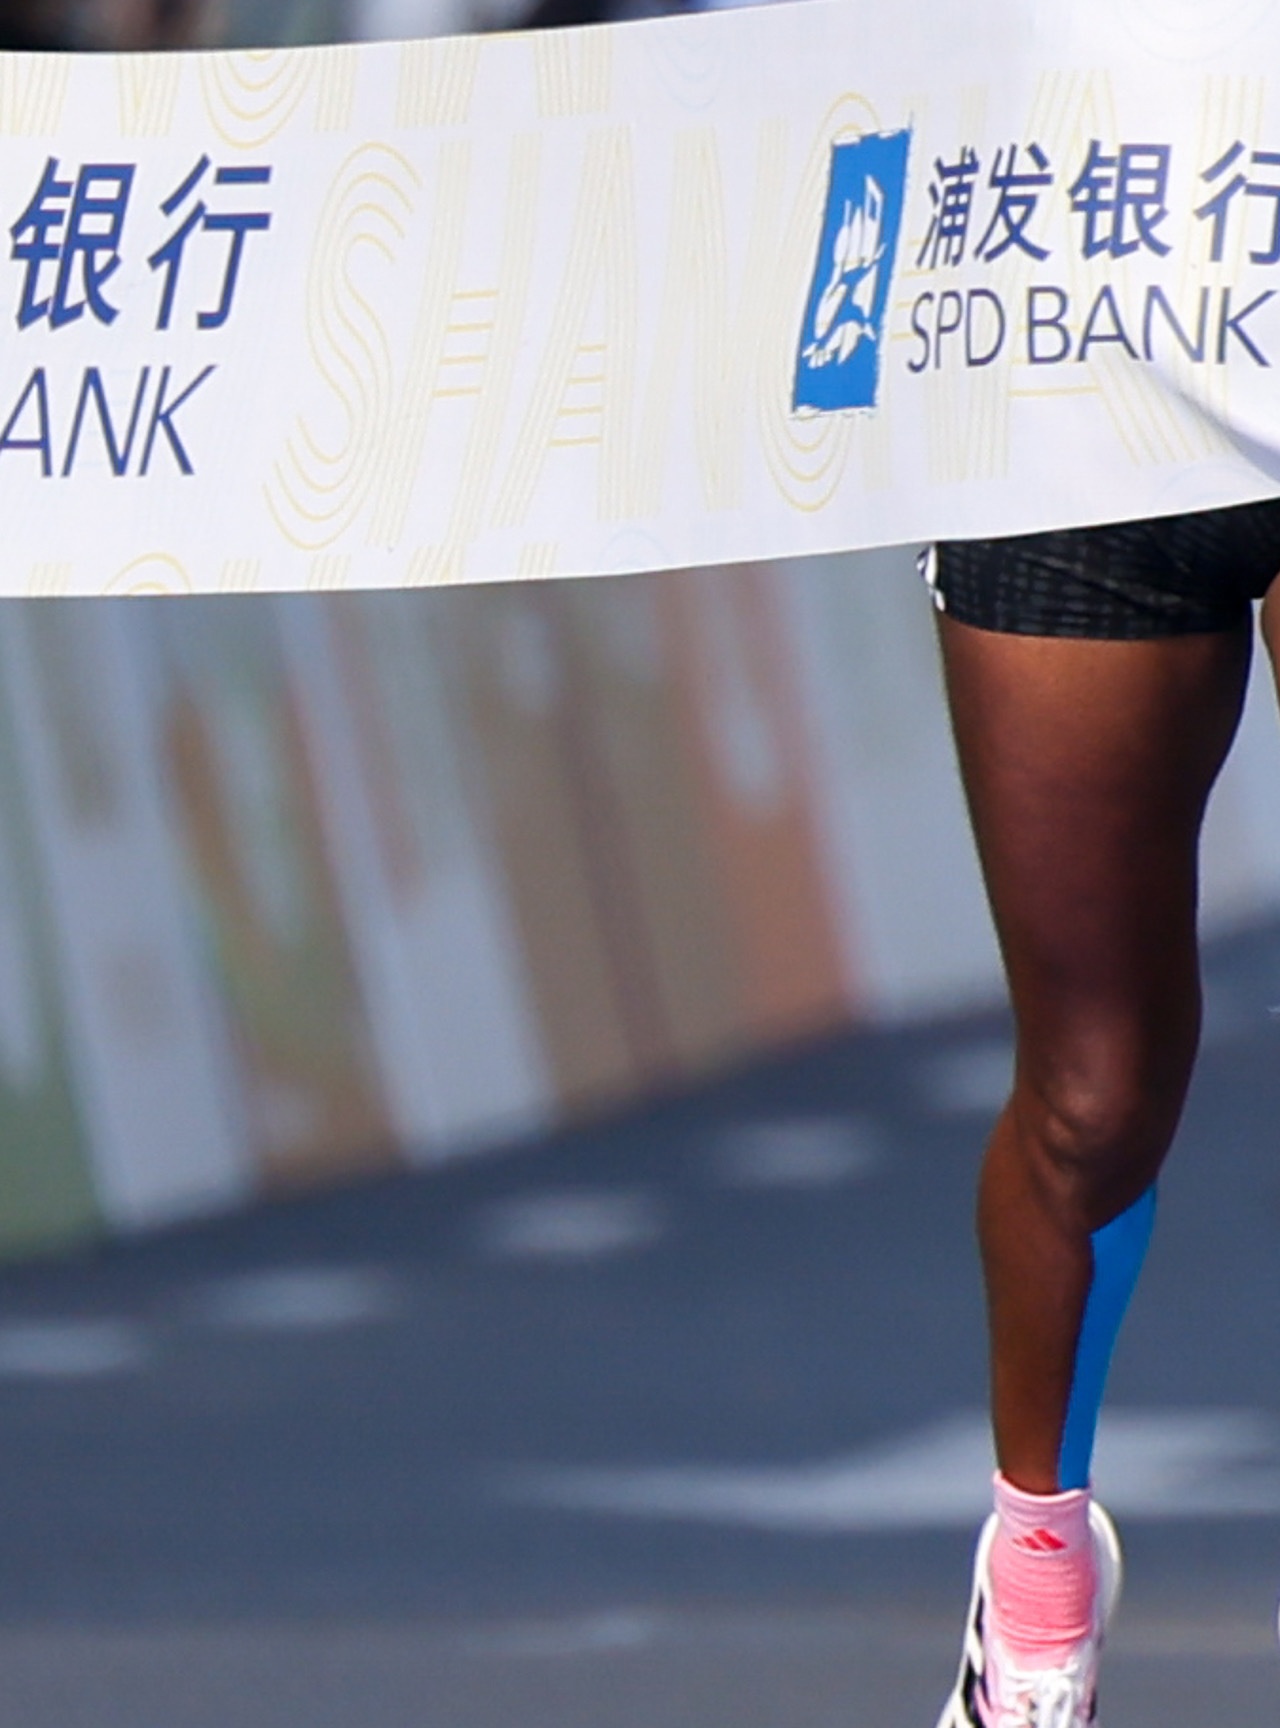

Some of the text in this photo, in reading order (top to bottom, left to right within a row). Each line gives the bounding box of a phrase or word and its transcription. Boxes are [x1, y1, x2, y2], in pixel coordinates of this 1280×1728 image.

[9, 153, 273, 332] 银行
[905, 284, 1278, 373] SPD BANK
